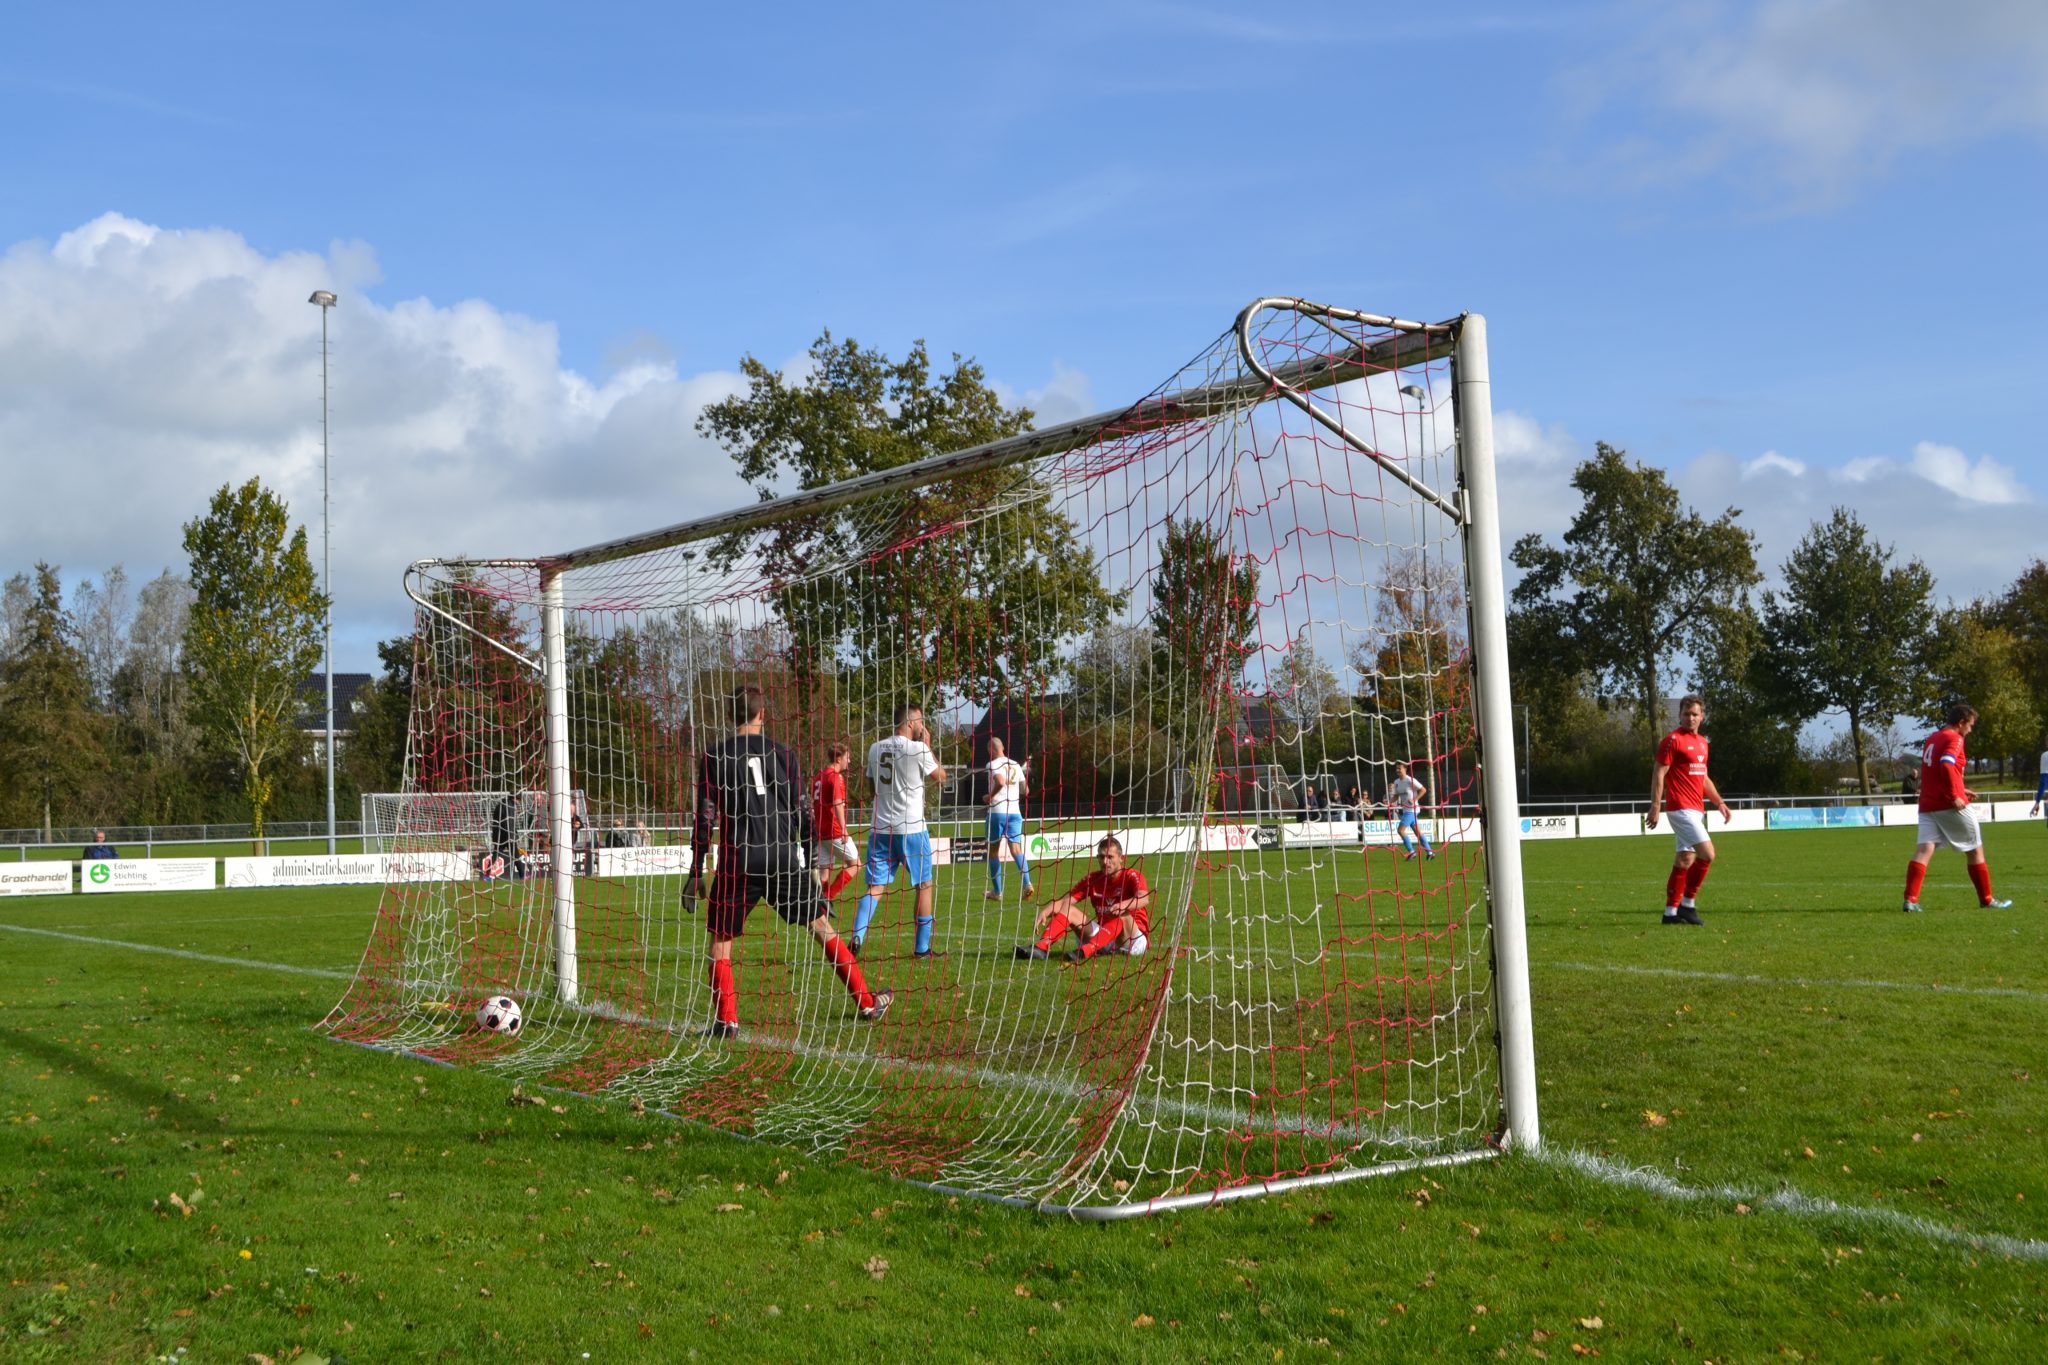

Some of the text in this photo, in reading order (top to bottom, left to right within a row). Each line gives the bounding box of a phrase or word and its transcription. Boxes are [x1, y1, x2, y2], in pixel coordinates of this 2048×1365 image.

[879, 752, 894, 786] 5
[748, 756, 766, 795] 1
[1532, 819, 1542, 827] DE
[621, 851, 633, 860] DE
[634, 848, 662, 856] HARDE
[664, 848, 685, 858] KERN
[272, 857, 375, 877] administratiekantoor
[1, 872, 68, 883] Groothandel
[113, 871, 148, 881] Stichting
